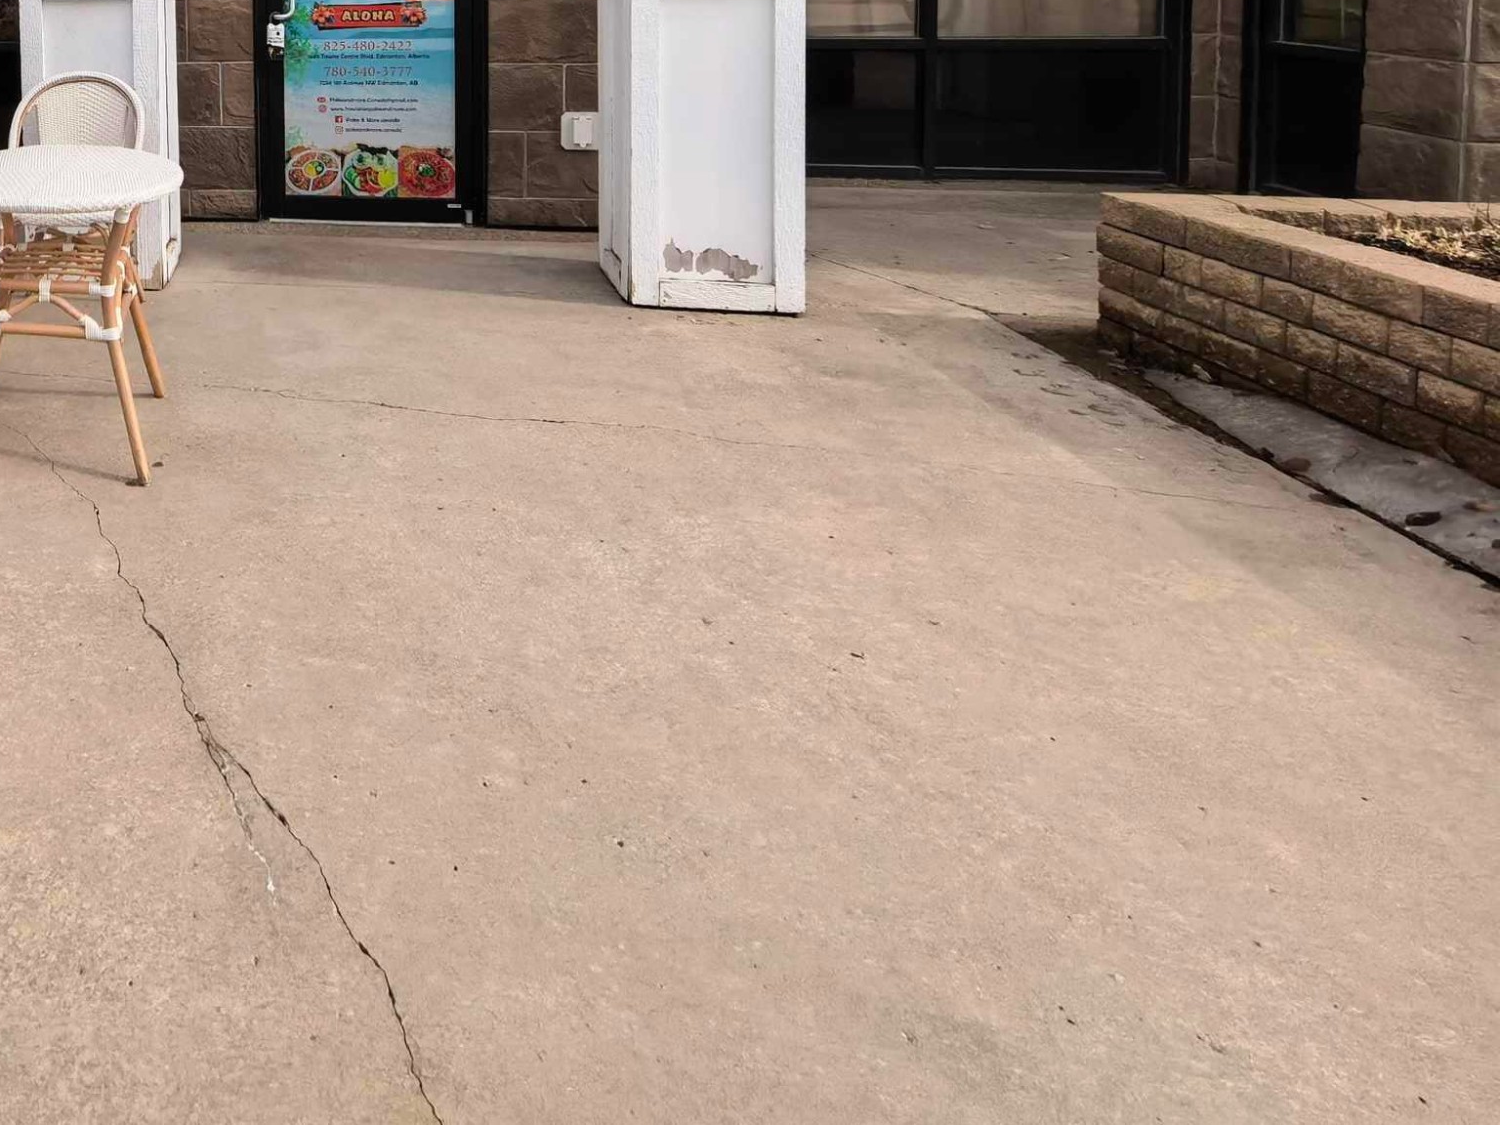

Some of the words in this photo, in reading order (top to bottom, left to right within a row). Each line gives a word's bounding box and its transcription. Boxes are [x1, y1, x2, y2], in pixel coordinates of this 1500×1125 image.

[341, 9, 395, 21] ALOHA
[323, 40, 412, 52] 825-480-2422
[323, 66, 412, 77] 780-540-3777
